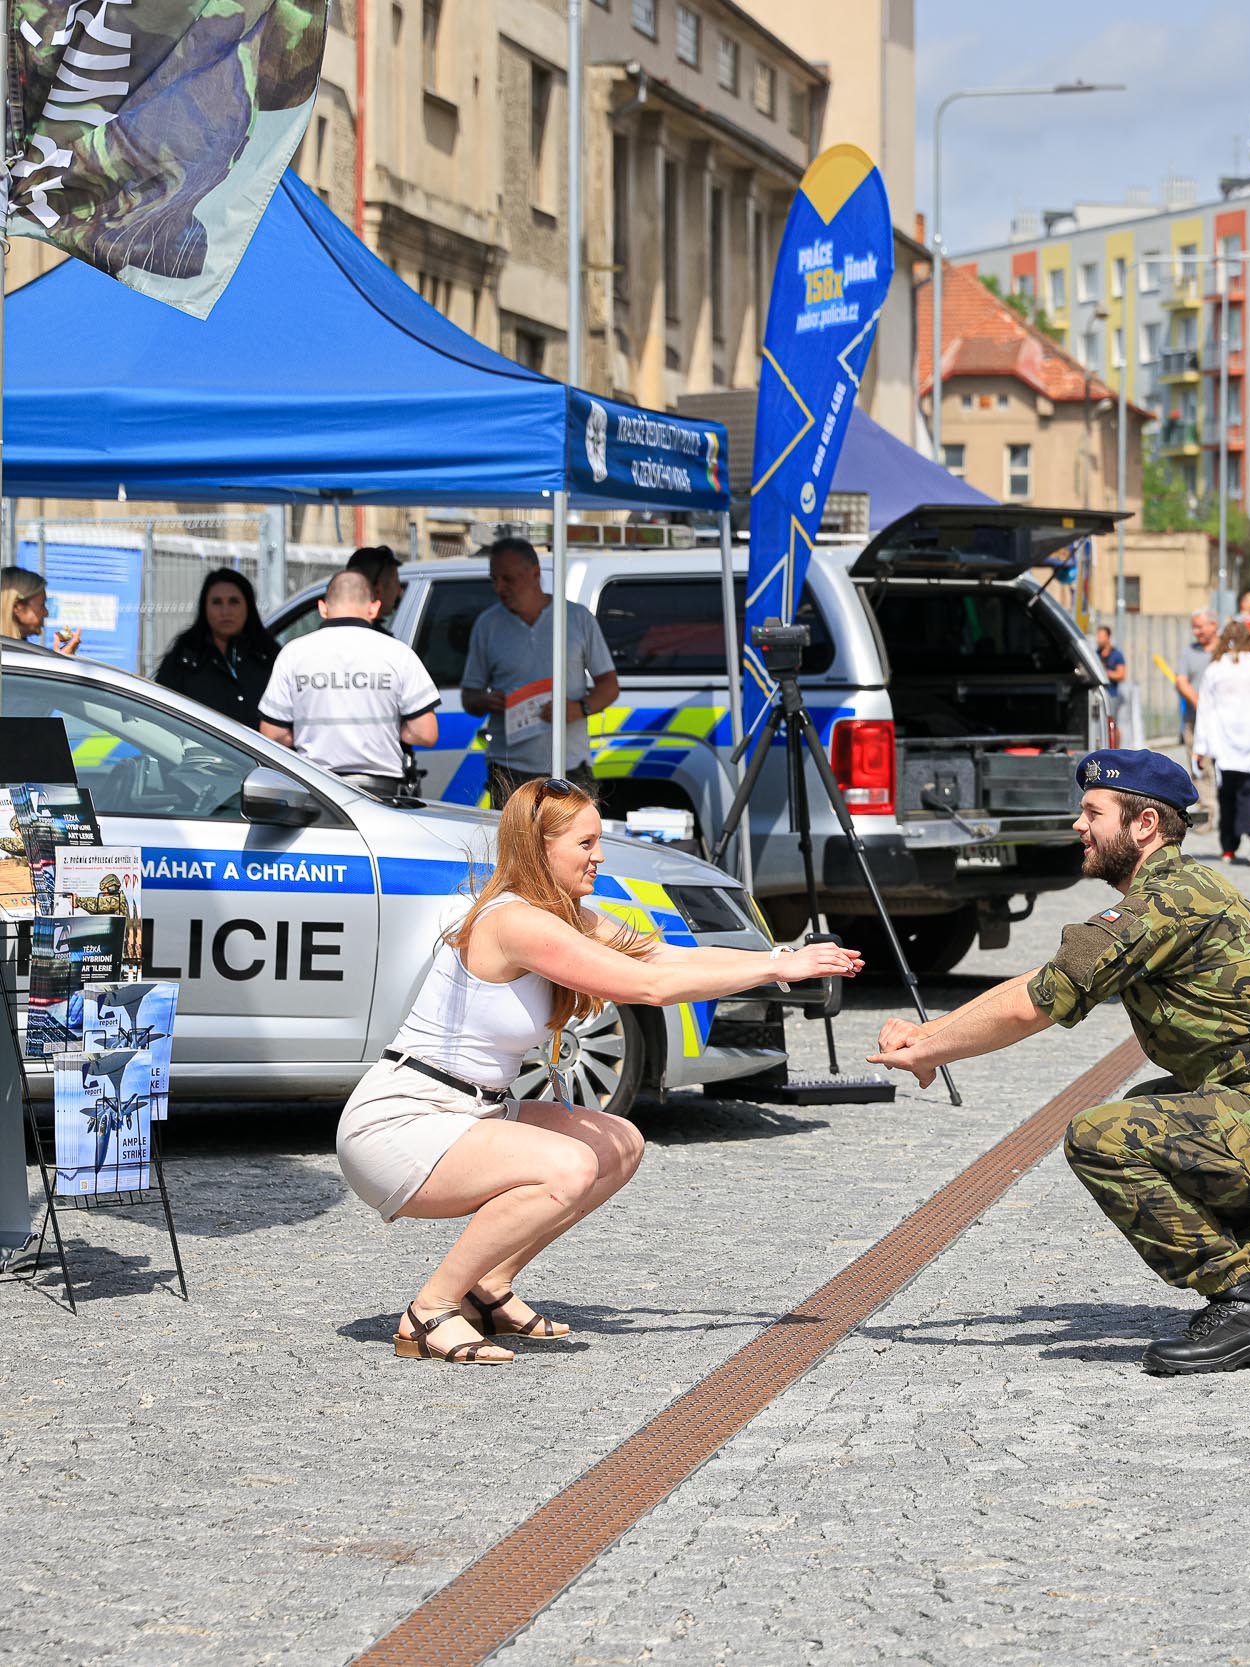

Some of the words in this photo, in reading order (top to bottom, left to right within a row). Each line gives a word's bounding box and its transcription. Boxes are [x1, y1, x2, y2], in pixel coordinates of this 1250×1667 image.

[295, 671, 392, 692] POLICIE
[141, 856, 216, 879] MÁHAT
[222, 863, 240, 879] A
[246, 859, 348, 883] CHRÁNIT
[141, 918, 346, 981] LICIE
[100, 1018, 118, 1027] report
[84, 1088, 102, 1096] report
